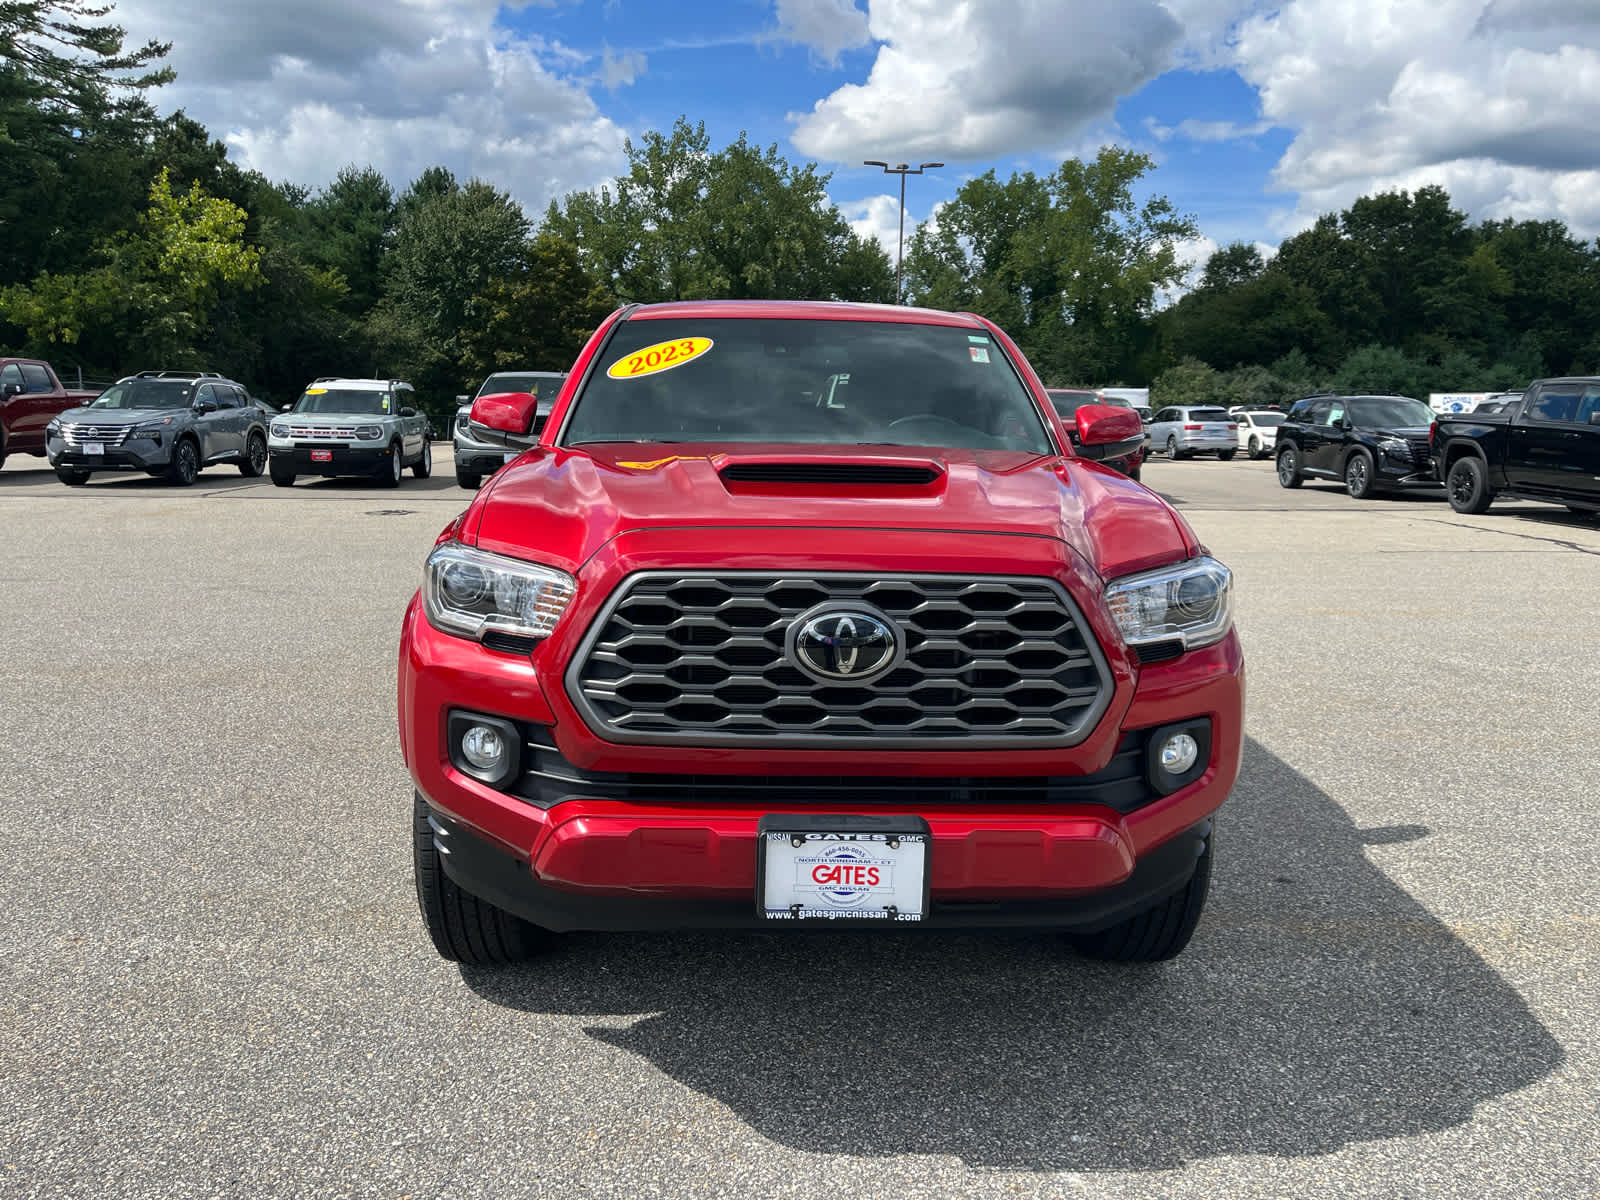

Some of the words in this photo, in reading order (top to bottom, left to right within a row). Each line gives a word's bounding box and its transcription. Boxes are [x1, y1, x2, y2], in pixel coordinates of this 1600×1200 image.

[628, 340, 695, 374] 2023
[766, 833, 791, 841] NISSAN
[804, 833, 887, 841] GATES
[812, 864, 880, 886] GATES
[799, 910, 888, 920] gatesgmcnissan
[894, 913, 921, 921] .com
